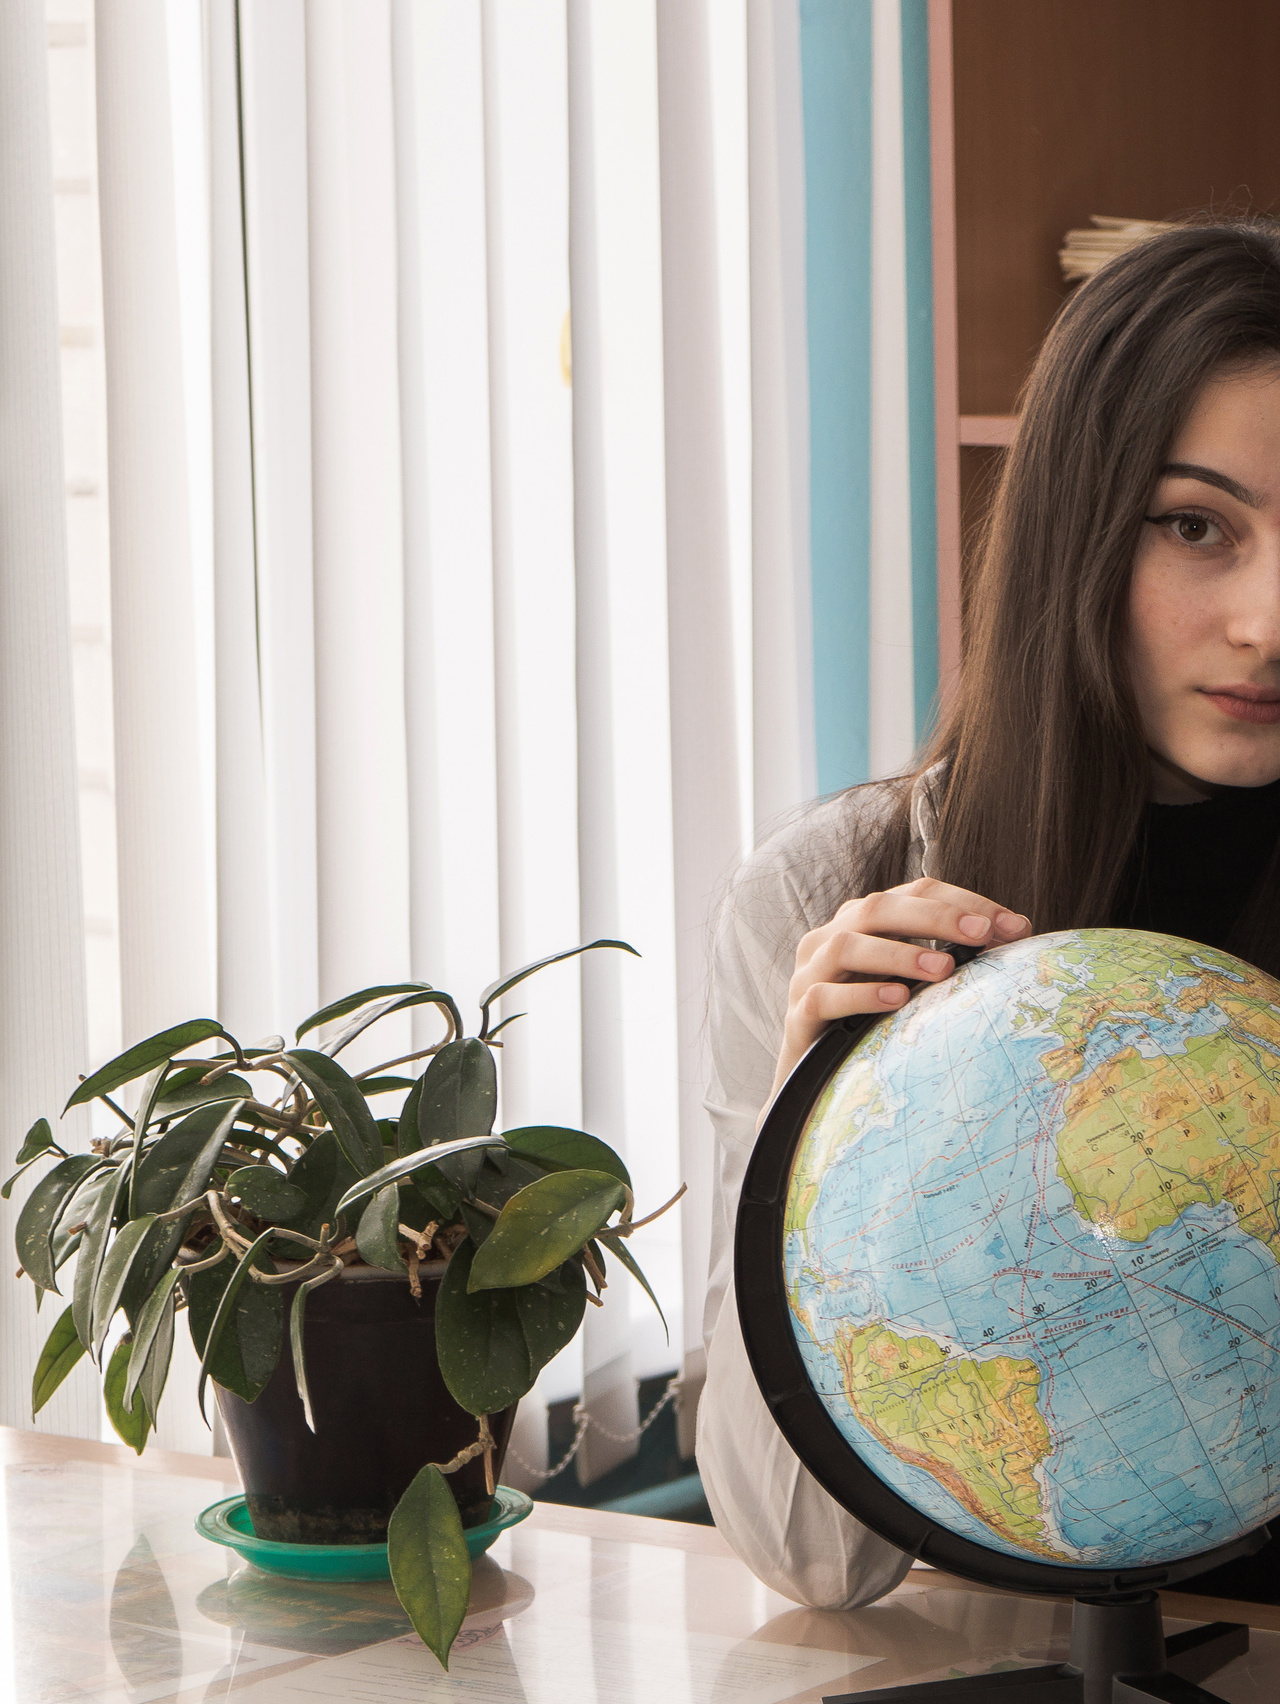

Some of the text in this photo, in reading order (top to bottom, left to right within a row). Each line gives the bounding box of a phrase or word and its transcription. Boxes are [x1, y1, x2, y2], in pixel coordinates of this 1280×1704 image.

[1130, 1129, 1145, 1143] 20°
[1159, 1179, 1174, 1193] 10°
[1186, 1228, 1195, 1240] 0°
[891, 1259, 927, 1270] СЕВЕРНОЕ
[934, 1234, 973, 1264] ПАССАТНОЕ
[1131, 1253, 1145, 1267] 10°
[992, 1266, 1112, 1279] МЕЖПАССАТНОЕ ПРОТИВОТЕЧЕНИЕ
[1084, 1277, 1099, 1291] 20°
[1209, 1283, 1224, 1299] 10°
[1032, 1302, 1046, 1316] 30°
[1008, 1332, 1036, 1342] ЮЖНОЕ
[1044, 1319, 1087, 1334] ПАССАТНОЕ
[1095, 1306, 1130, 1320] ТЕЧЕНИЕ
[982, 1326, 996, 1338] 40°
[1228, 1334, 1244, 1349] 20°
[940, 1344, 952, 1356] 50°
[1243, 1382, 1259, 1396] 30°
